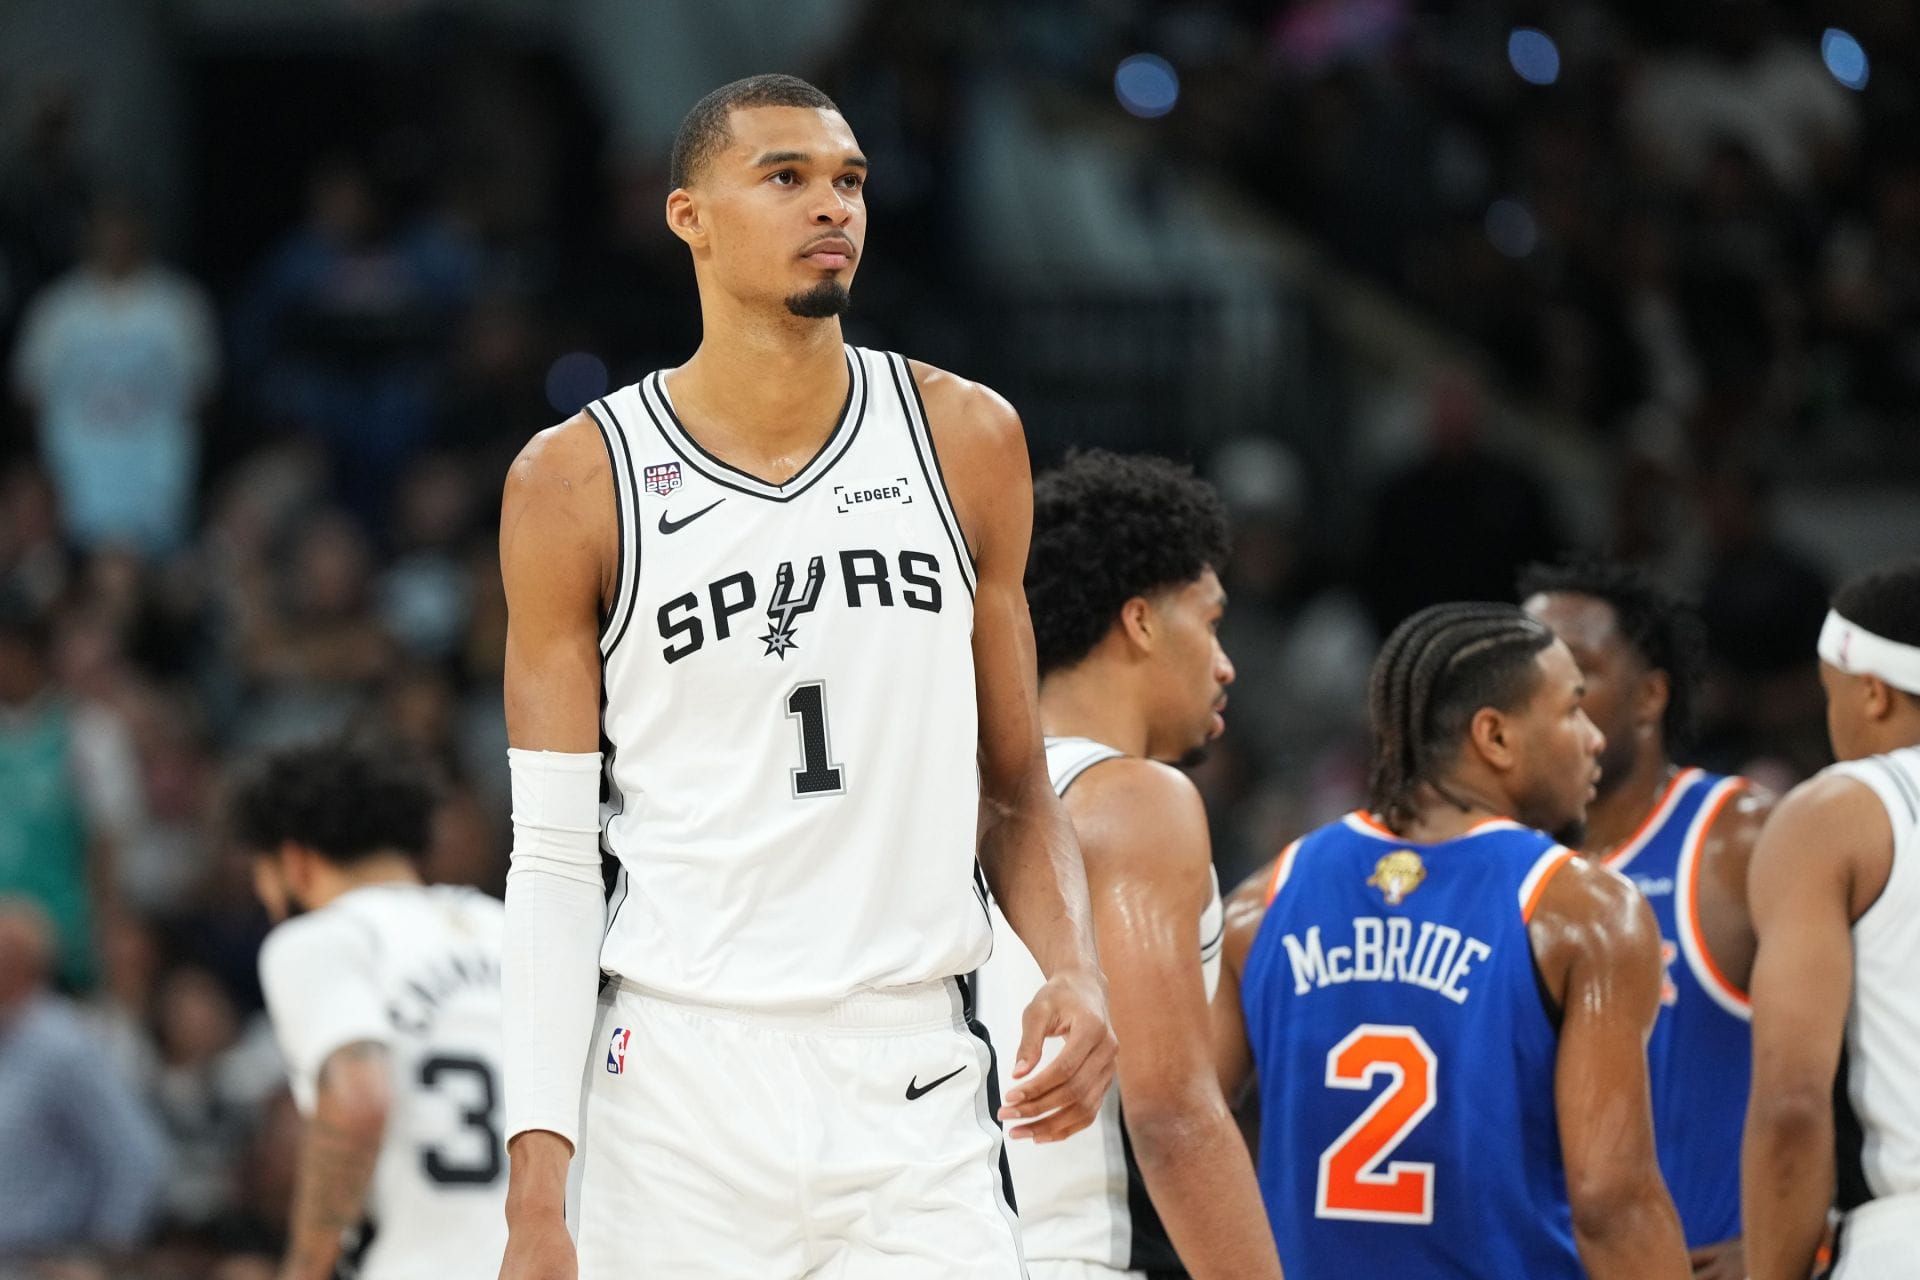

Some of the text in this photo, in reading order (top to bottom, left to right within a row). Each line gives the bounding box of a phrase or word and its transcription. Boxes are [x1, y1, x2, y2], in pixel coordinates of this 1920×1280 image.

[646, 465, 679, 477] USA
[646, 478, 682, 492] 250
[844, 486, 902, 505] LEDGER
[656, 548, 943, 665] SPURS
[784, 678, 847, 800] 1
[1282, 916, 1492, 1005] McBRIDE
[1314, 1022, 1438, 1225] 2
